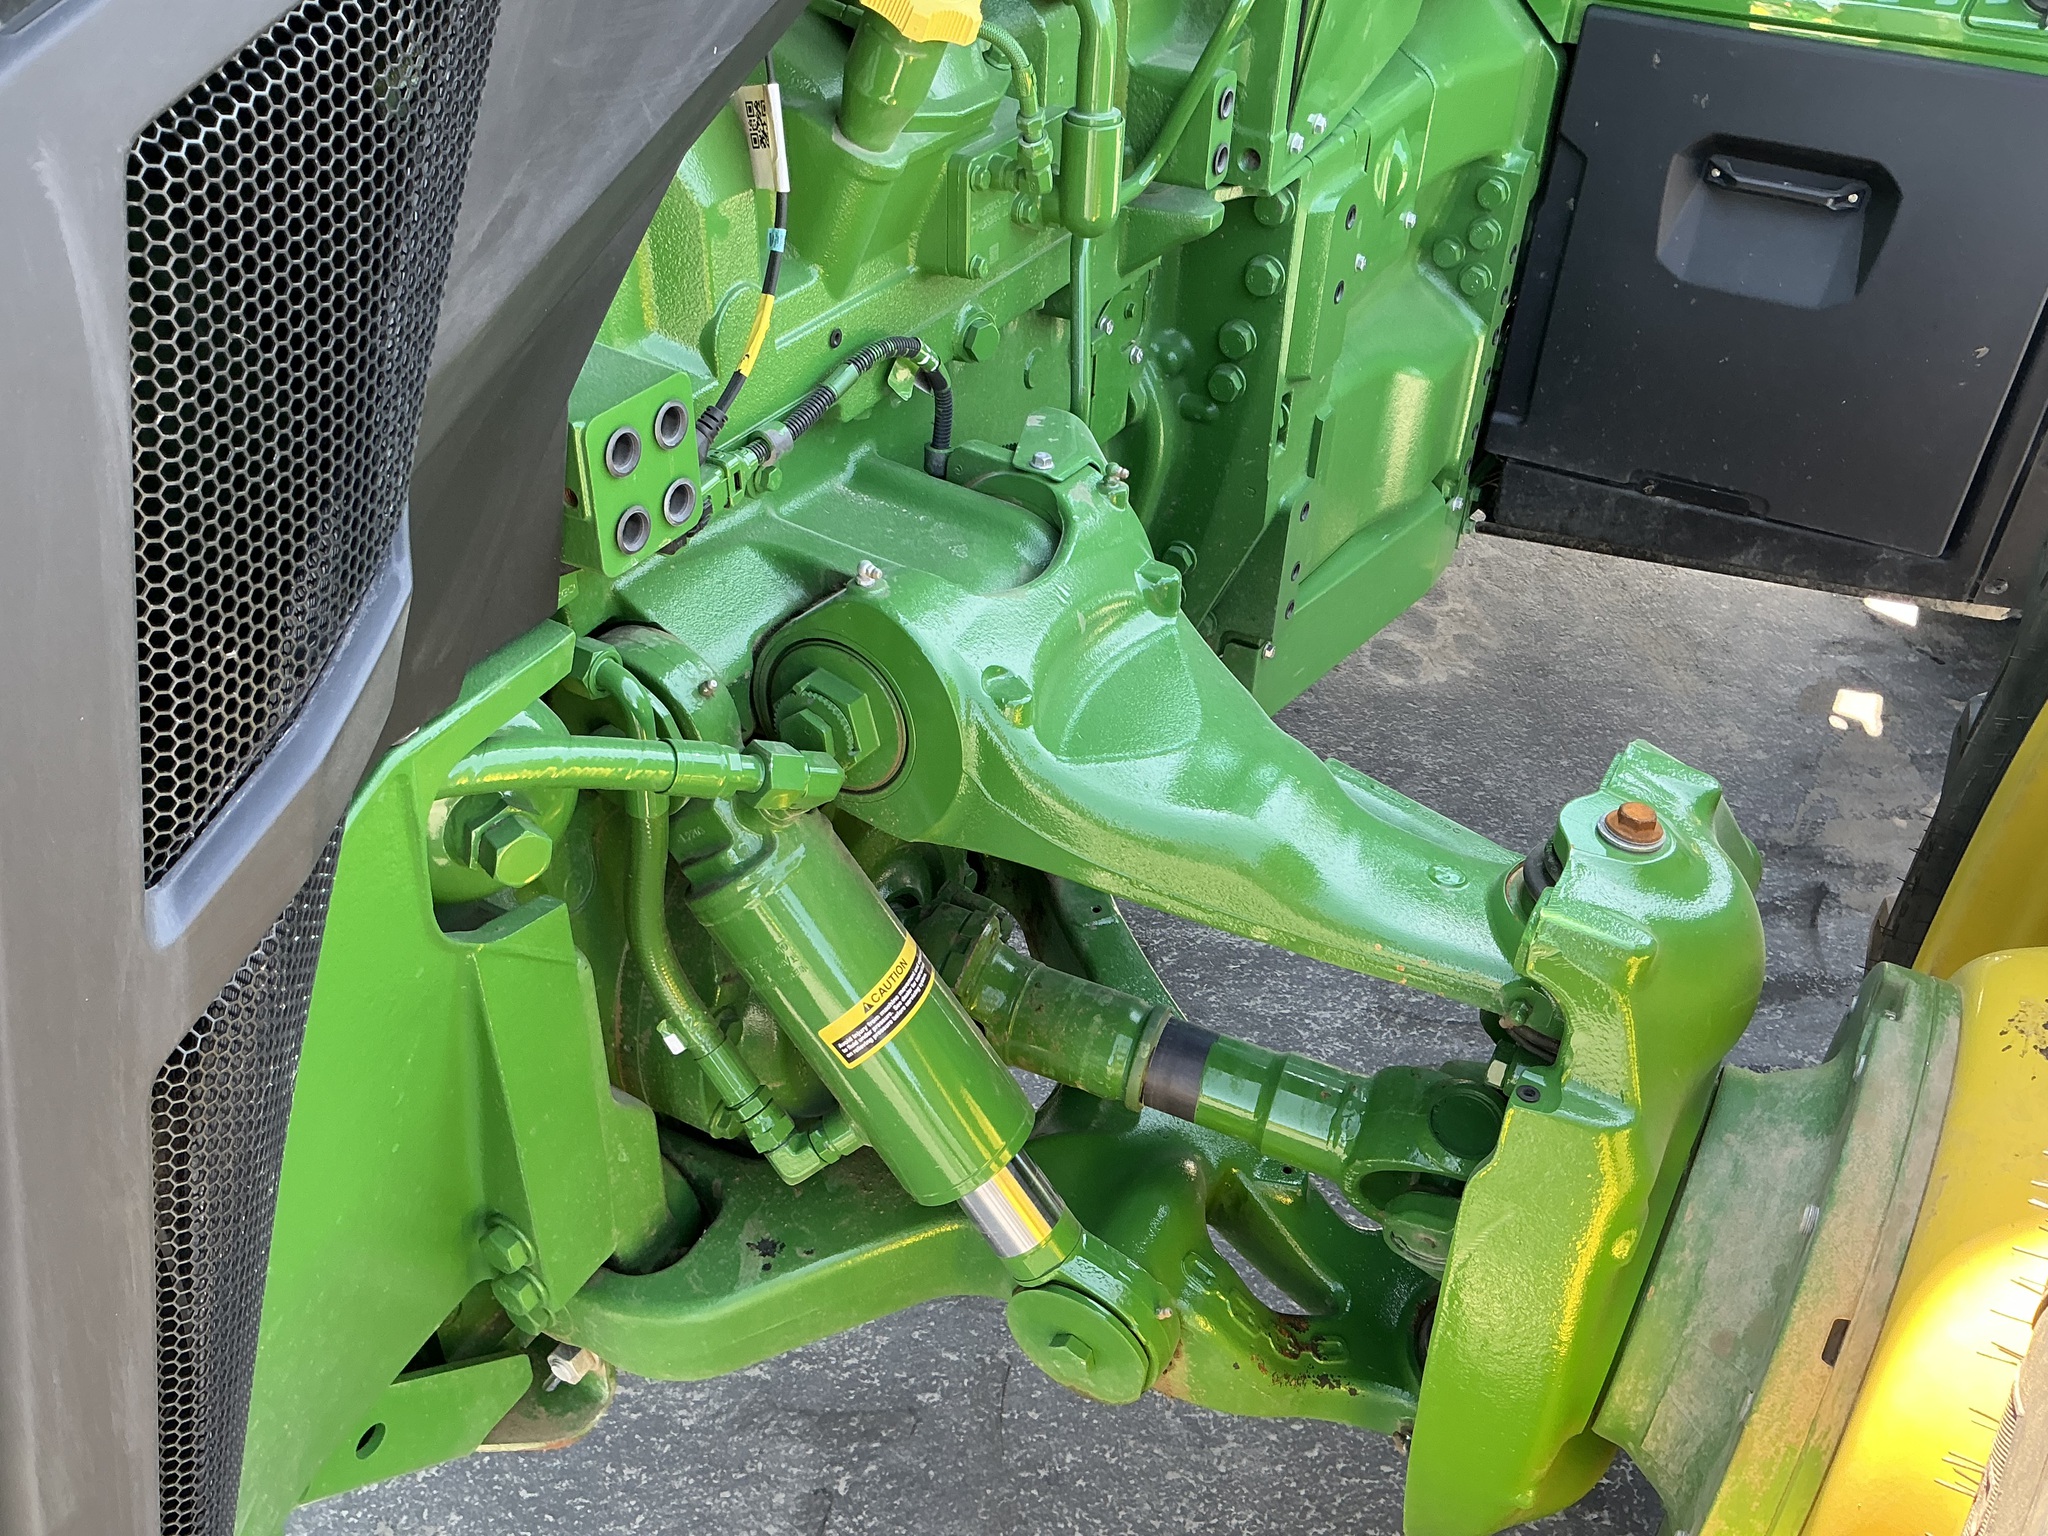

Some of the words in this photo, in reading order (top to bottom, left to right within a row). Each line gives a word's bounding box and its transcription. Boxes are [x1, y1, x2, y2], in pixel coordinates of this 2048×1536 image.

[871, 958, 908, 1003] CAUTION
[838, 1036, 853, 1048] Avoid
[866, 1014, 881, 1027] from
[879, 994, 900, 1017] machine
[858, 1030, 872, 1043] under
[892, 1000, 903, 1011] See
[901, 986, 913, 1002] dealer
[872, 1019, 894, 1041] pressure
[891, 1005, 907, 1021] before
